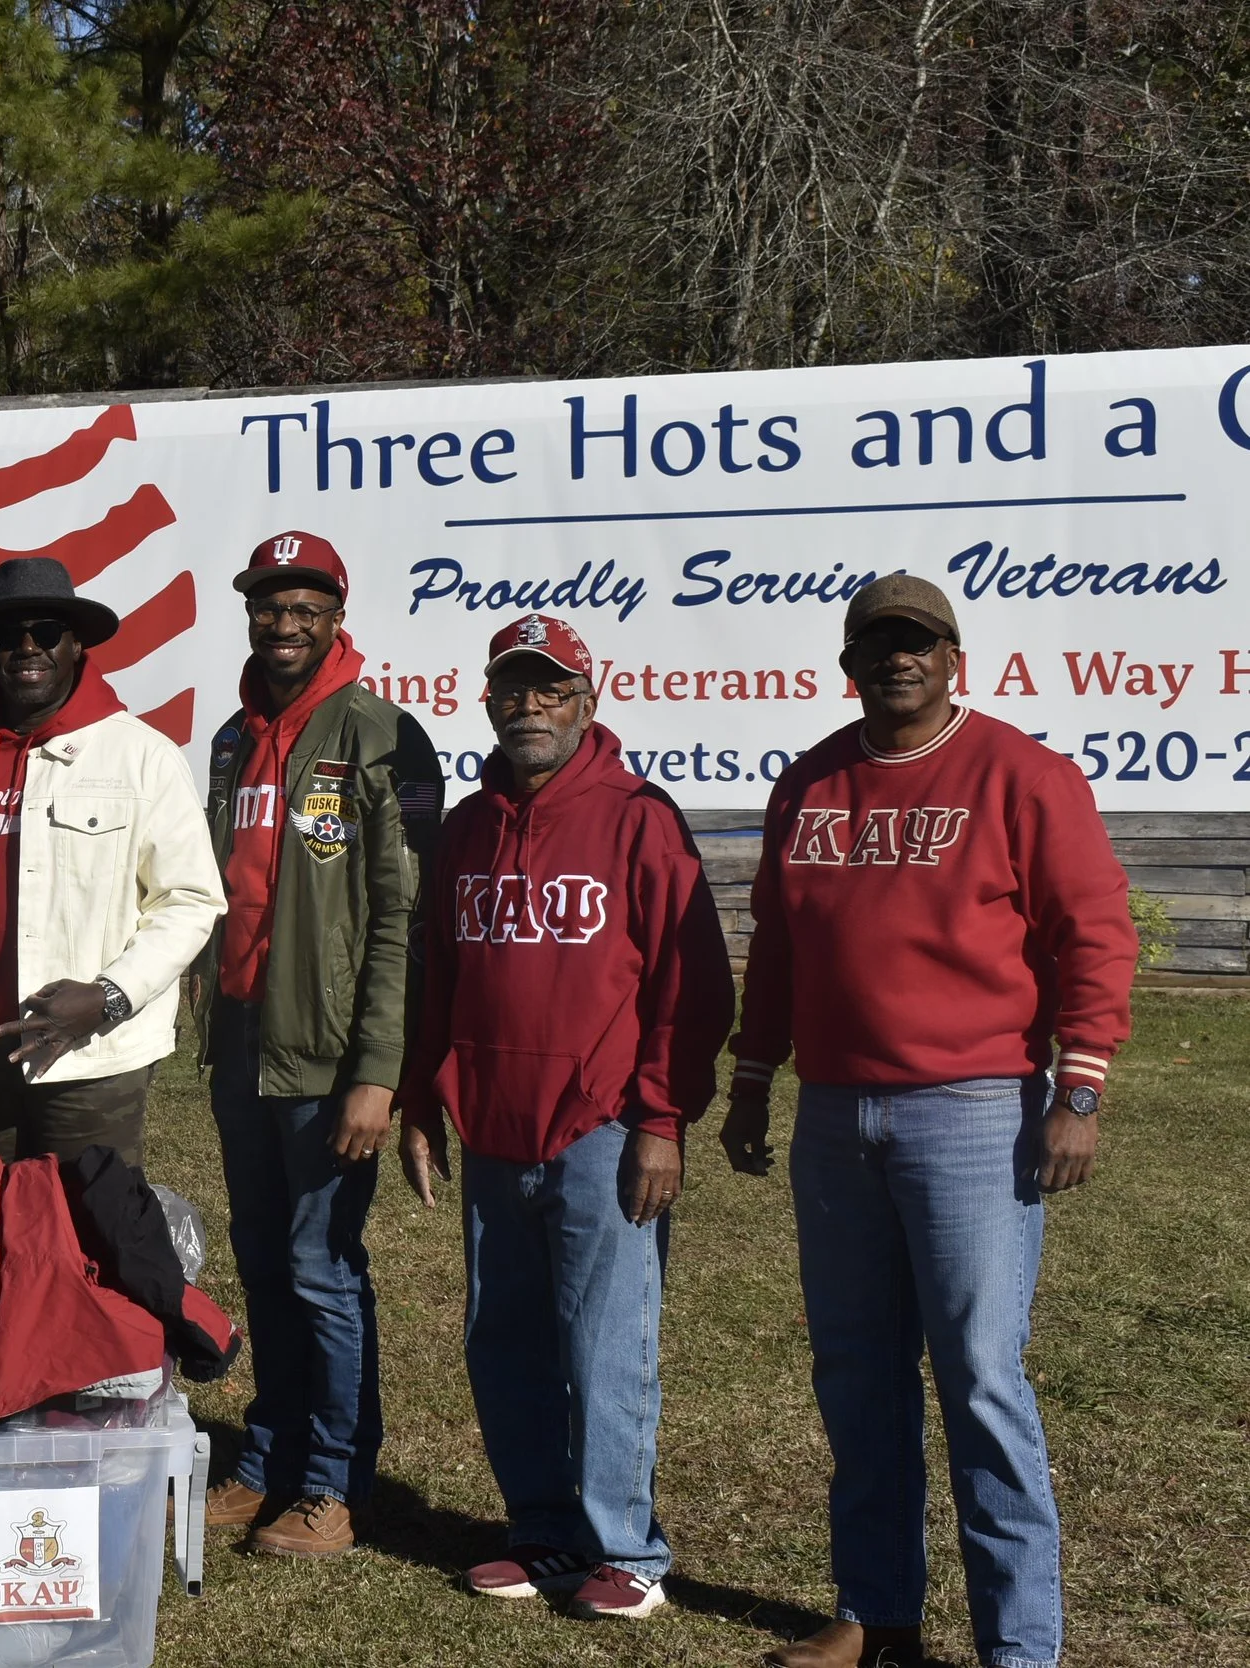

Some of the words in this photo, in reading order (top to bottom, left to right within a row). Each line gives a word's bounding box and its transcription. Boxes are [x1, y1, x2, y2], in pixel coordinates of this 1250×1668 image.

[241, 399, 518, 494] Three
[563, 393, 802, 480] Hots
[850, 359, 1047, 468] and
[1103, 397, 1157, 458] a
[409, 557, 647, 622] Proudly
[672, 549, 907, 606] Servin
[947, 540, 1228, 601] Veterans
[994, 652, 1039, 696] A
[1062, 650, 1195, 709] Way
[306, 837, 343, 854] AIRMEN
